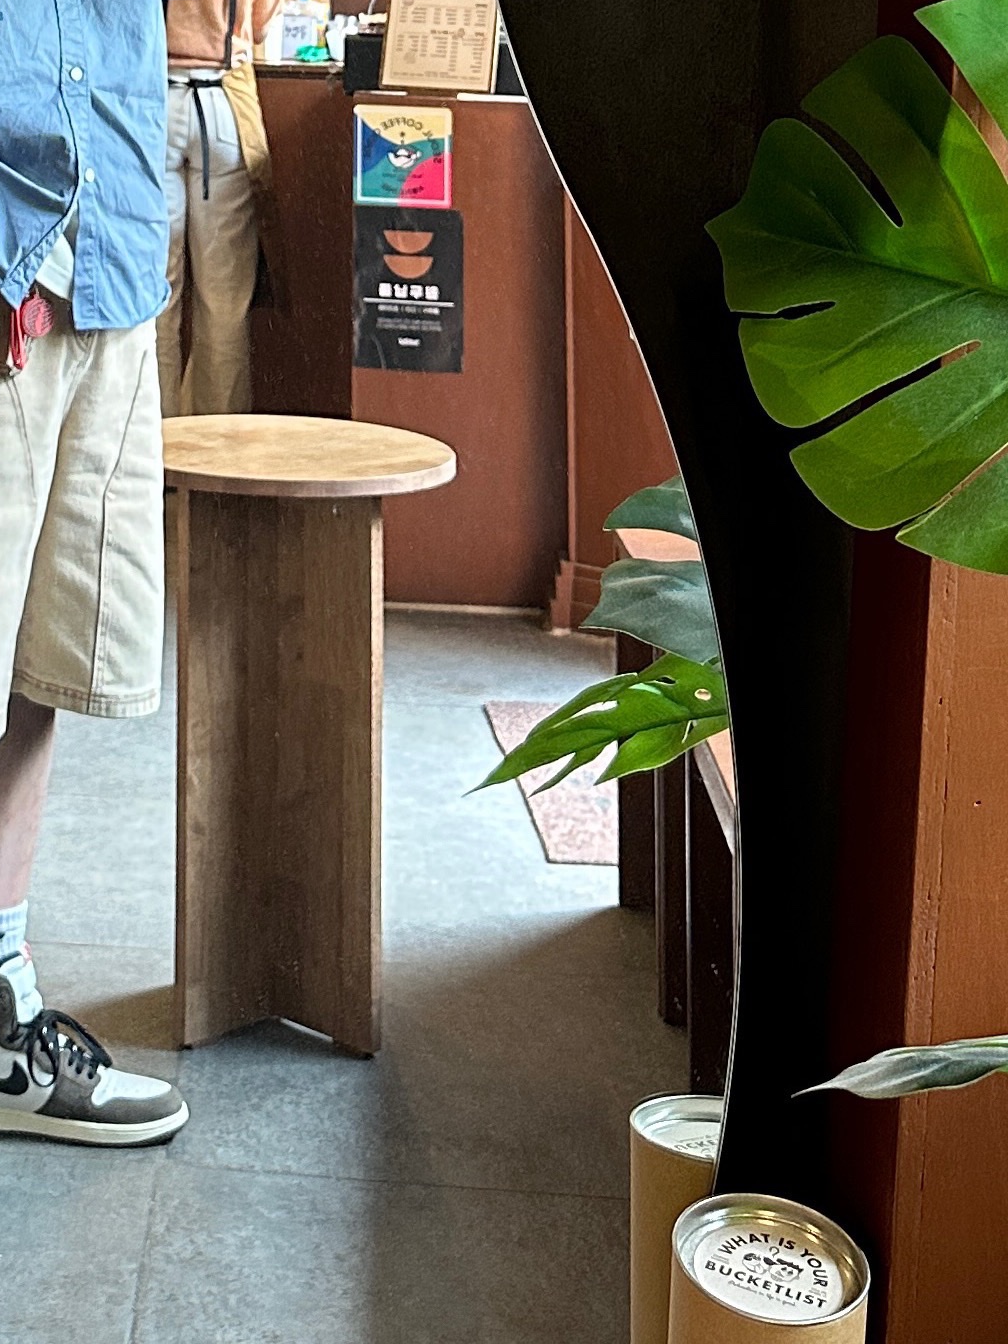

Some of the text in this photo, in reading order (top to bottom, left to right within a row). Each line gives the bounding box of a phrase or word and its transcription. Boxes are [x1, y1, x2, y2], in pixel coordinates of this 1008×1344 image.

[705, 1259, 827, 1308] BUCKETLIST
[717, 1233, 828, 1288] WHAT IS YOUR
